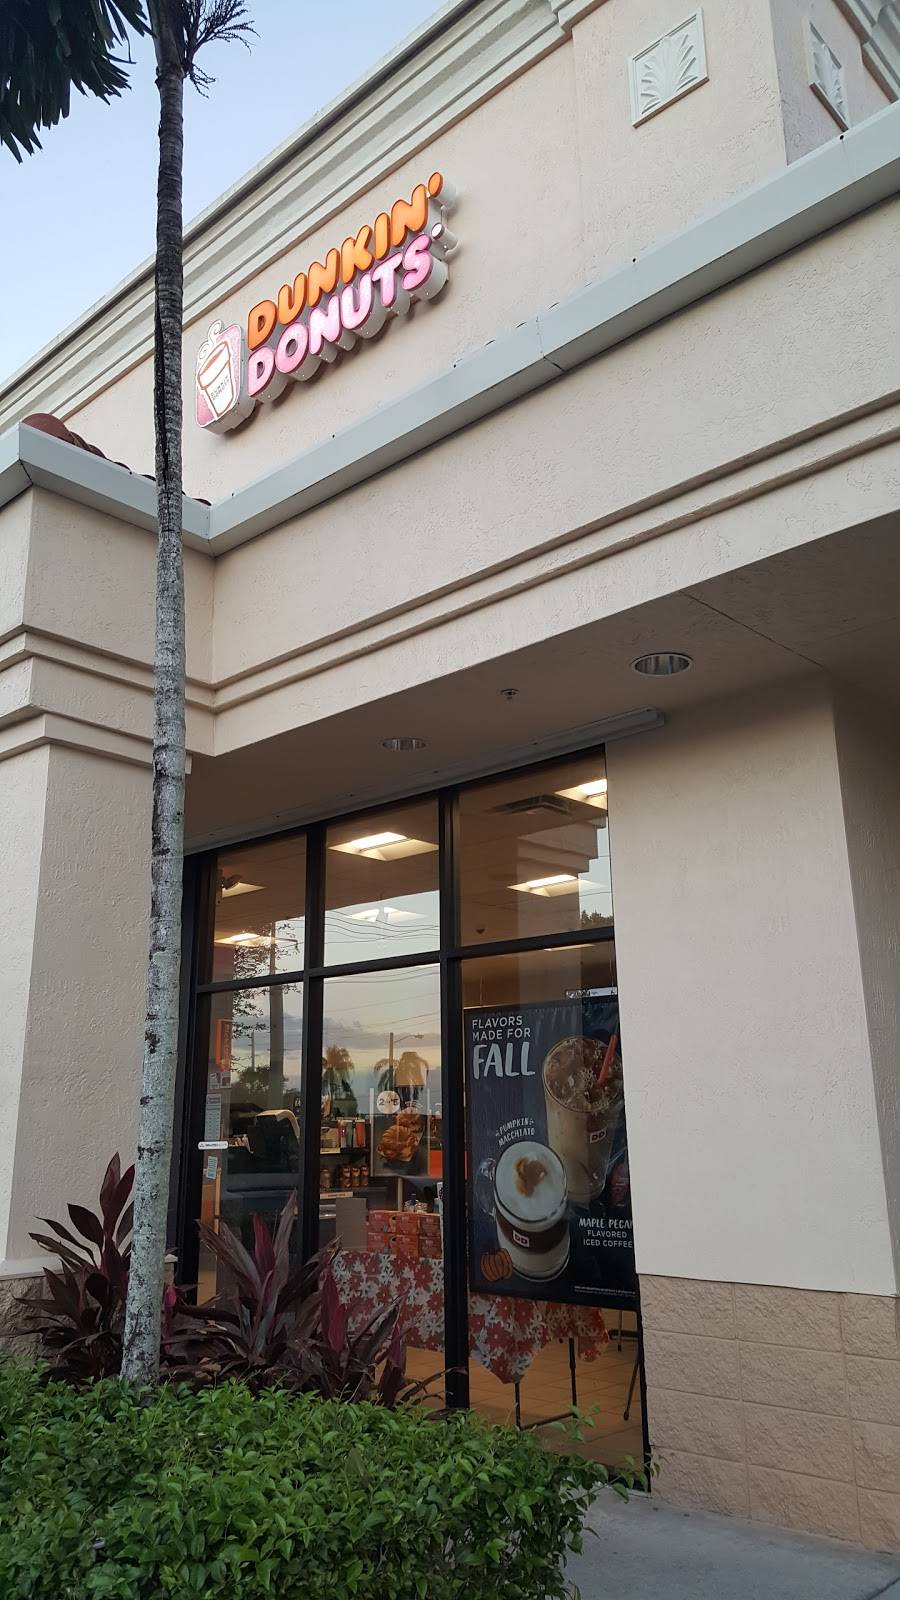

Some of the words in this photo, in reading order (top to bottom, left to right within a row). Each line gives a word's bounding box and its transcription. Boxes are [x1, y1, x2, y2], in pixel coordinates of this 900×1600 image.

[248, 172, 443, 350] DUNKIN'
[248, 233, 433, 397] DONUTS
[472, 1016, 523, 1029] FLAVORS
[472, 1029, 503, 1041] MADE
[507, 1027, 531, 1039] FOR
[472, 1041, 536, 1080] FALL
[499, 1117, 529, 1135] PUMPKIN
[498, 1127, 535, 1147] MACCHIATO
[578, 1217, 605, 1228] MAPLE
[587, 1229, 628, 1239] FLAVORED
[583, 1238, 601, 1247] ICED
[602, 1239, 633, 1249] COFFEE
